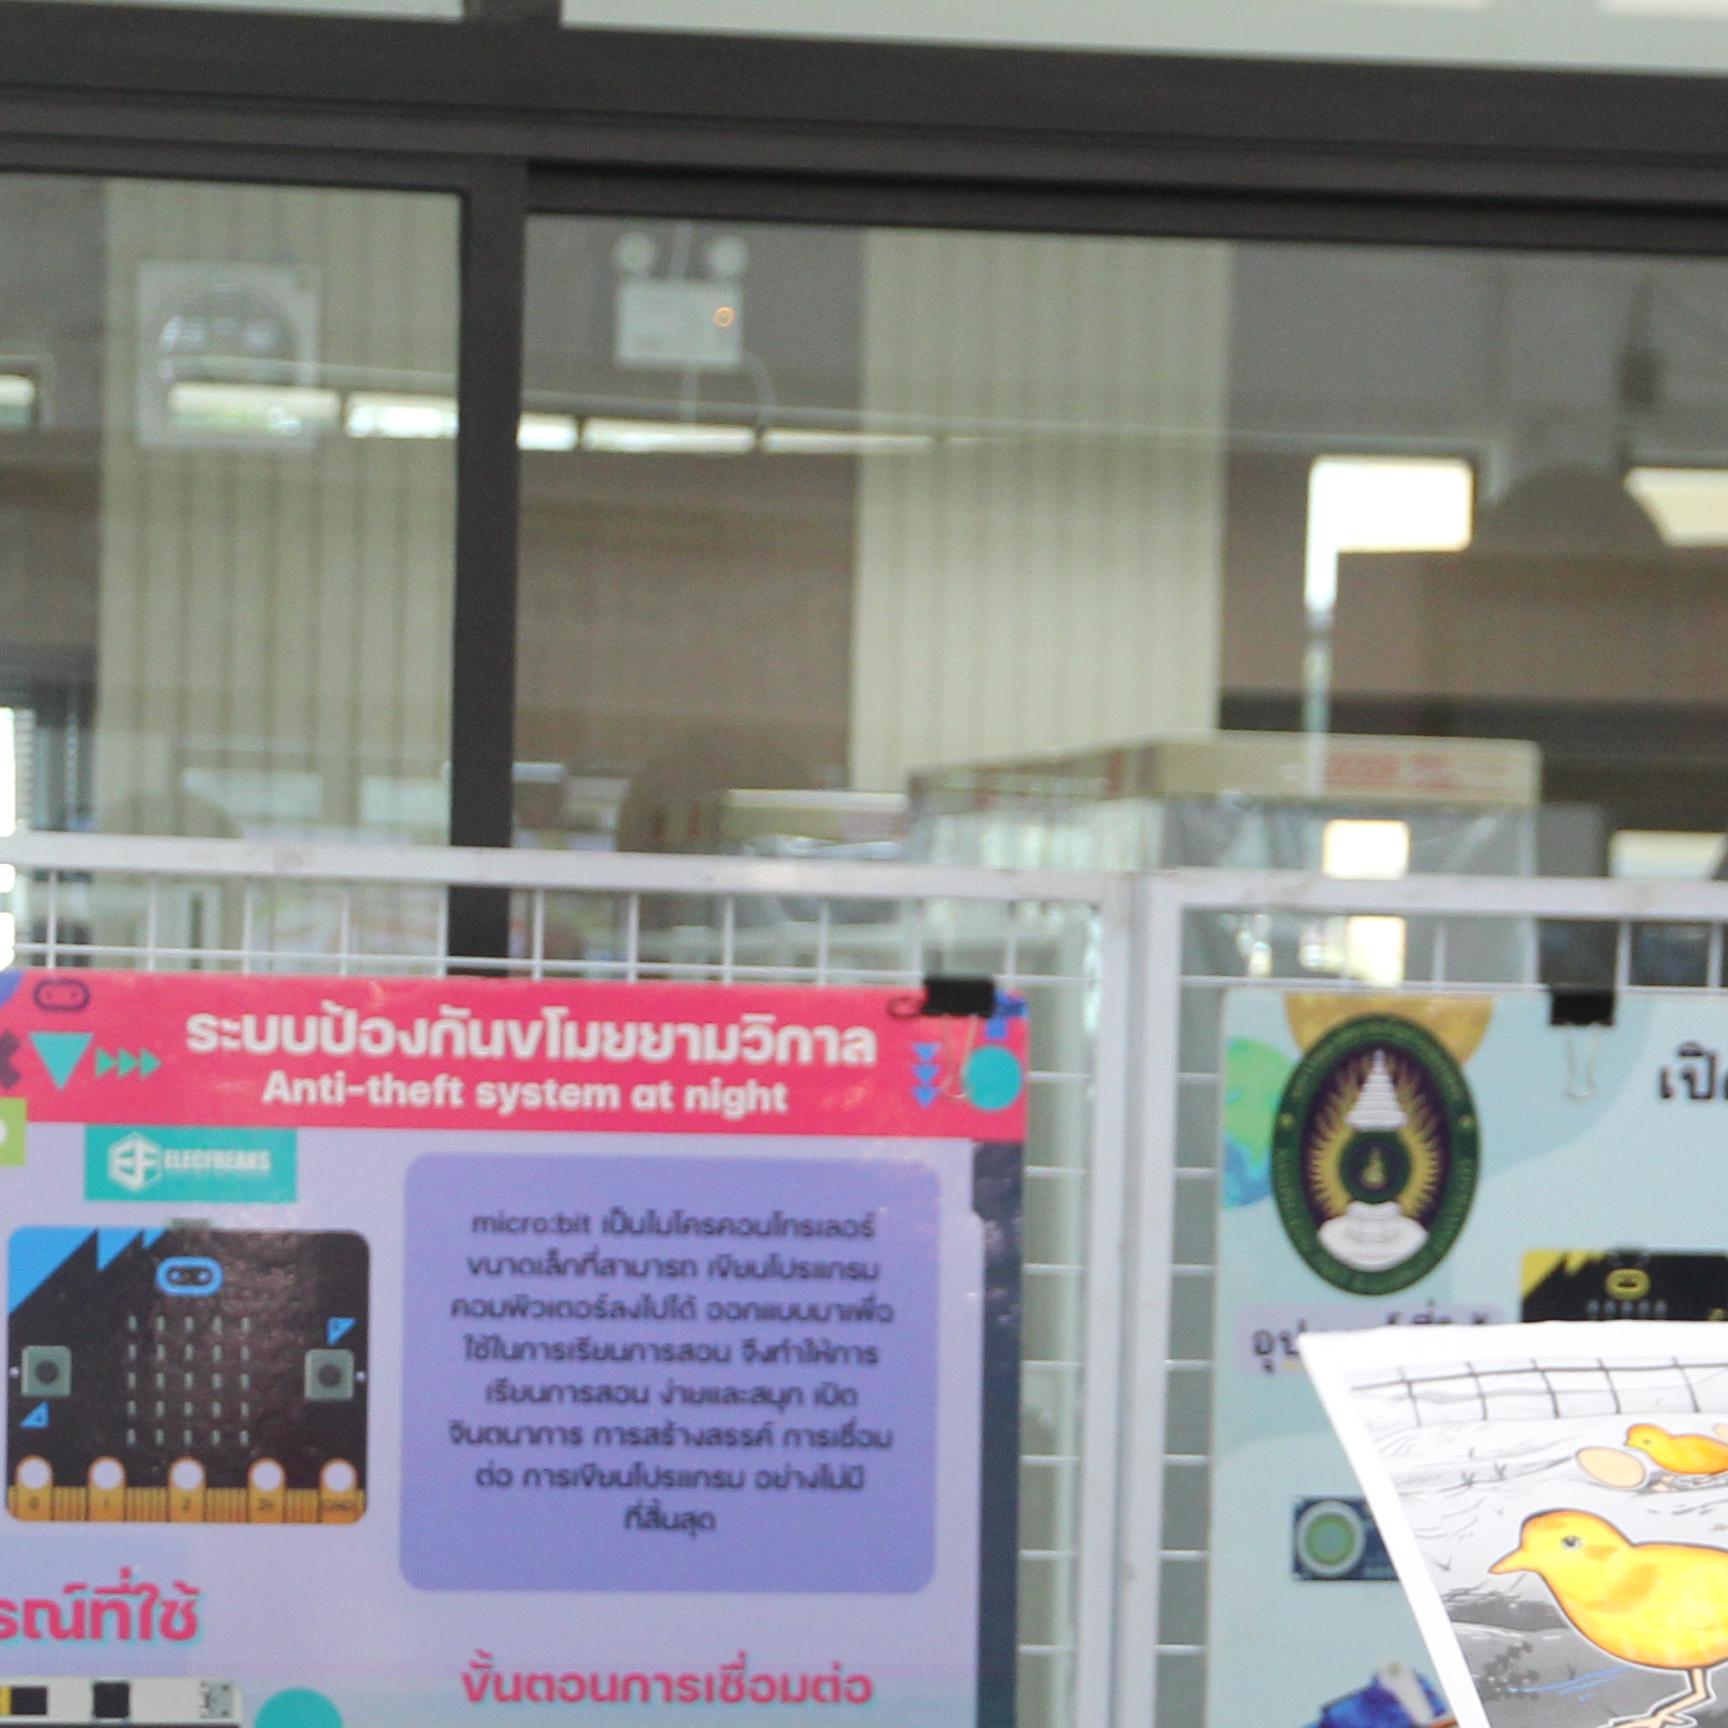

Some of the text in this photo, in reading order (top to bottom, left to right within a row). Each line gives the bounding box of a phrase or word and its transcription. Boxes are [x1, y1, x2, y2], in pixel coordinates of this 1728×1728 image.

[185, 1000, 878, 1066] ระบบป้องกันขโมยยามวิกาล
[262, 1070, 789, 1119] Anti-theft system at night
[472, 1213, 592, 1236] micro:bit
[461, 1650, 875, 1705] ขั้นตอนการเชื่อมต่อ
